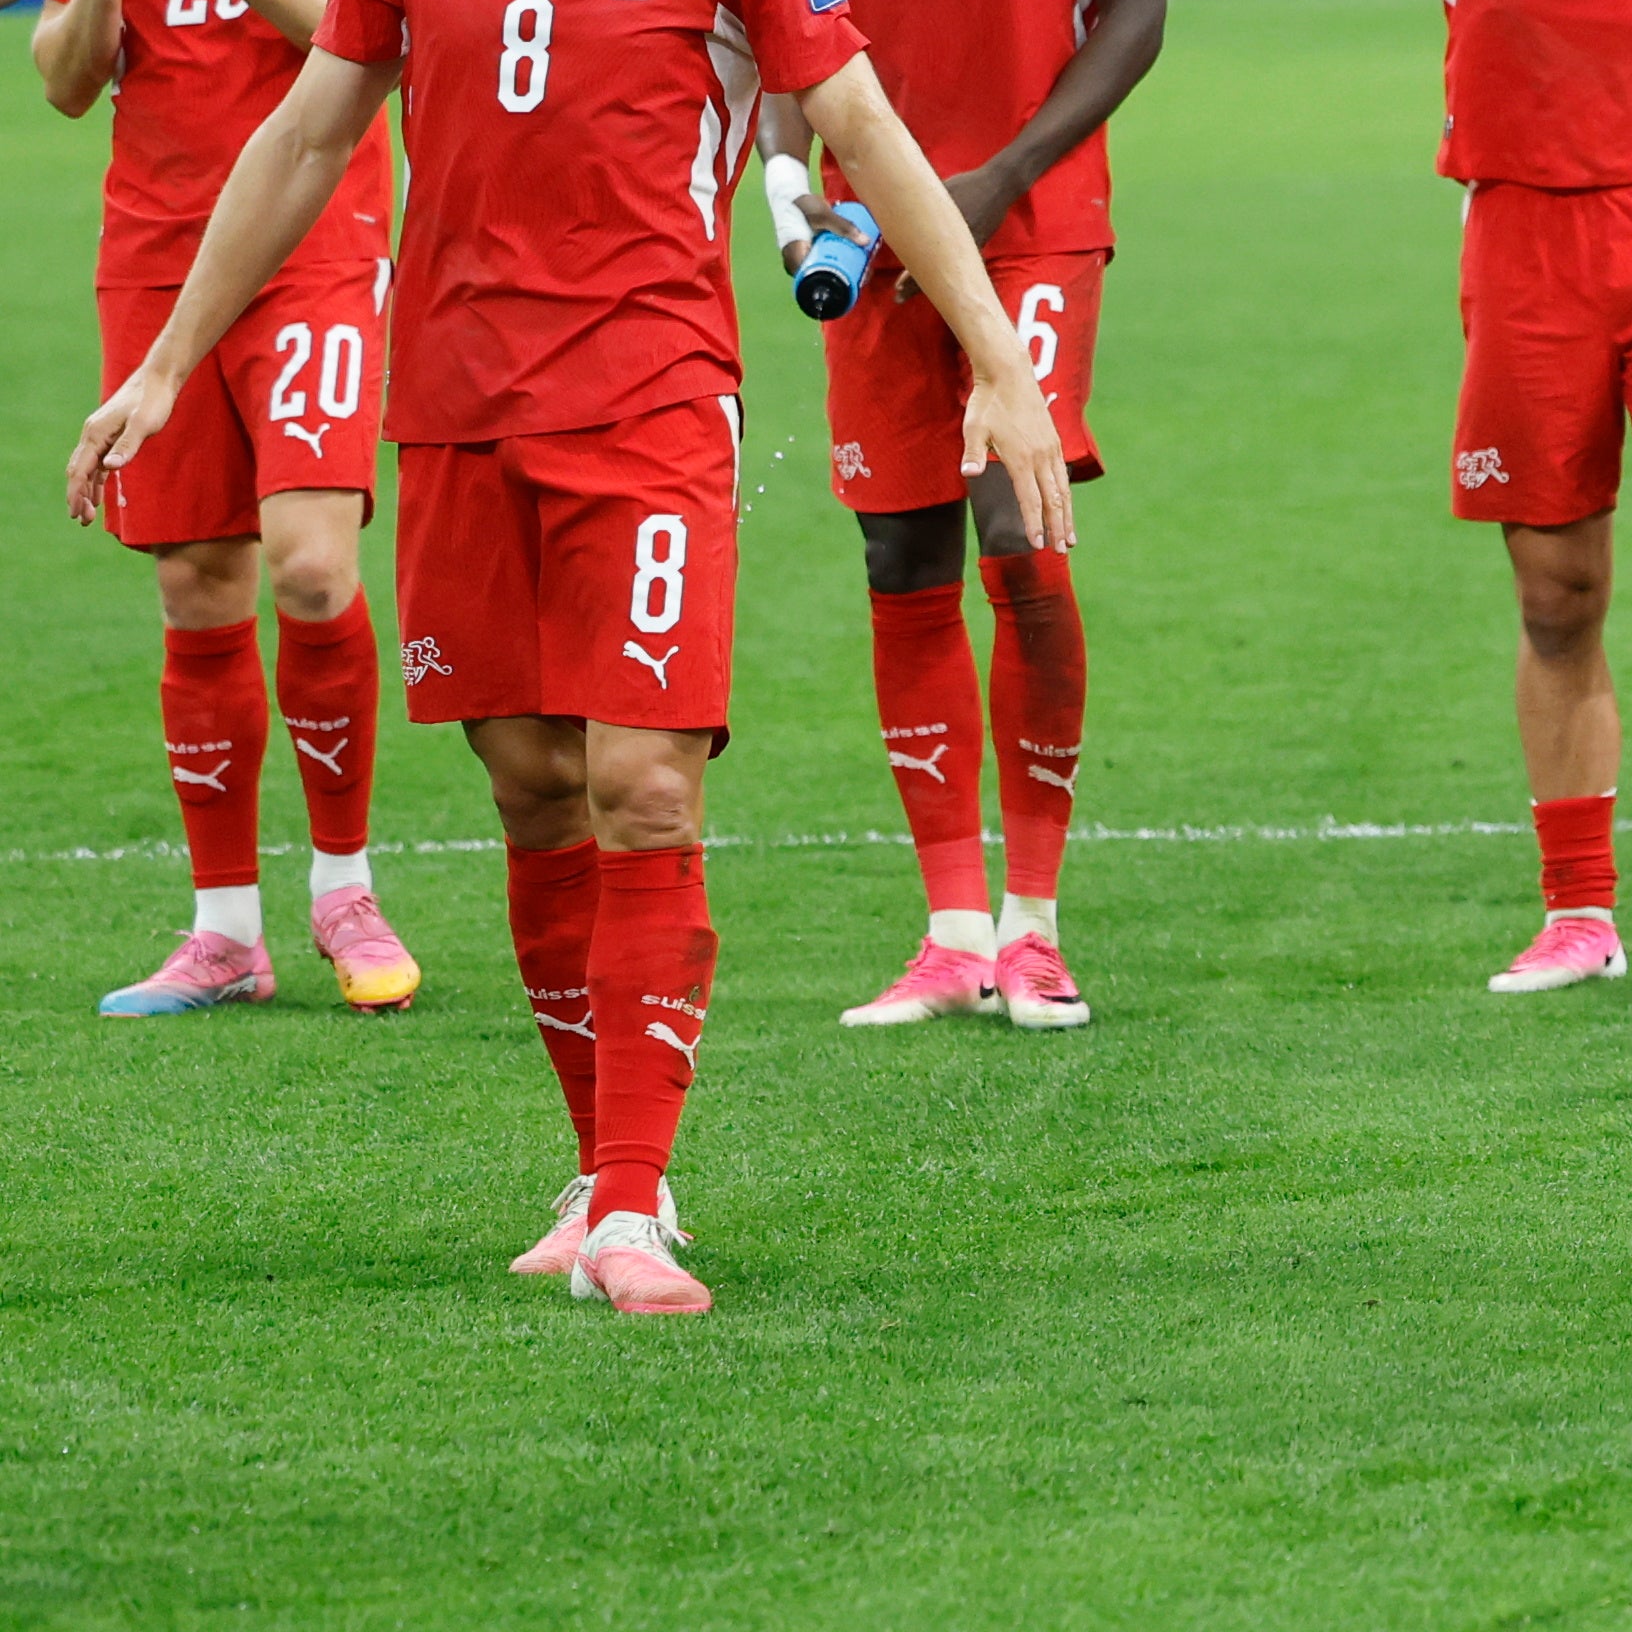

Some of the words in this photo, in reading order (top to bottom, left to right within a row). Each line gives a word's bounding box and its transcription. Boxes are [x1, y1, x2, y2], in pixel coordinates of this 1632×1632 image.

[269, 322, 363, 421] 20
[1017, 283, 1065, 382] 6
[630, 514, 686, 633] 8
[1018, 737, 1082, 758] suiss
[640, 993, 706, 1021] suiss
